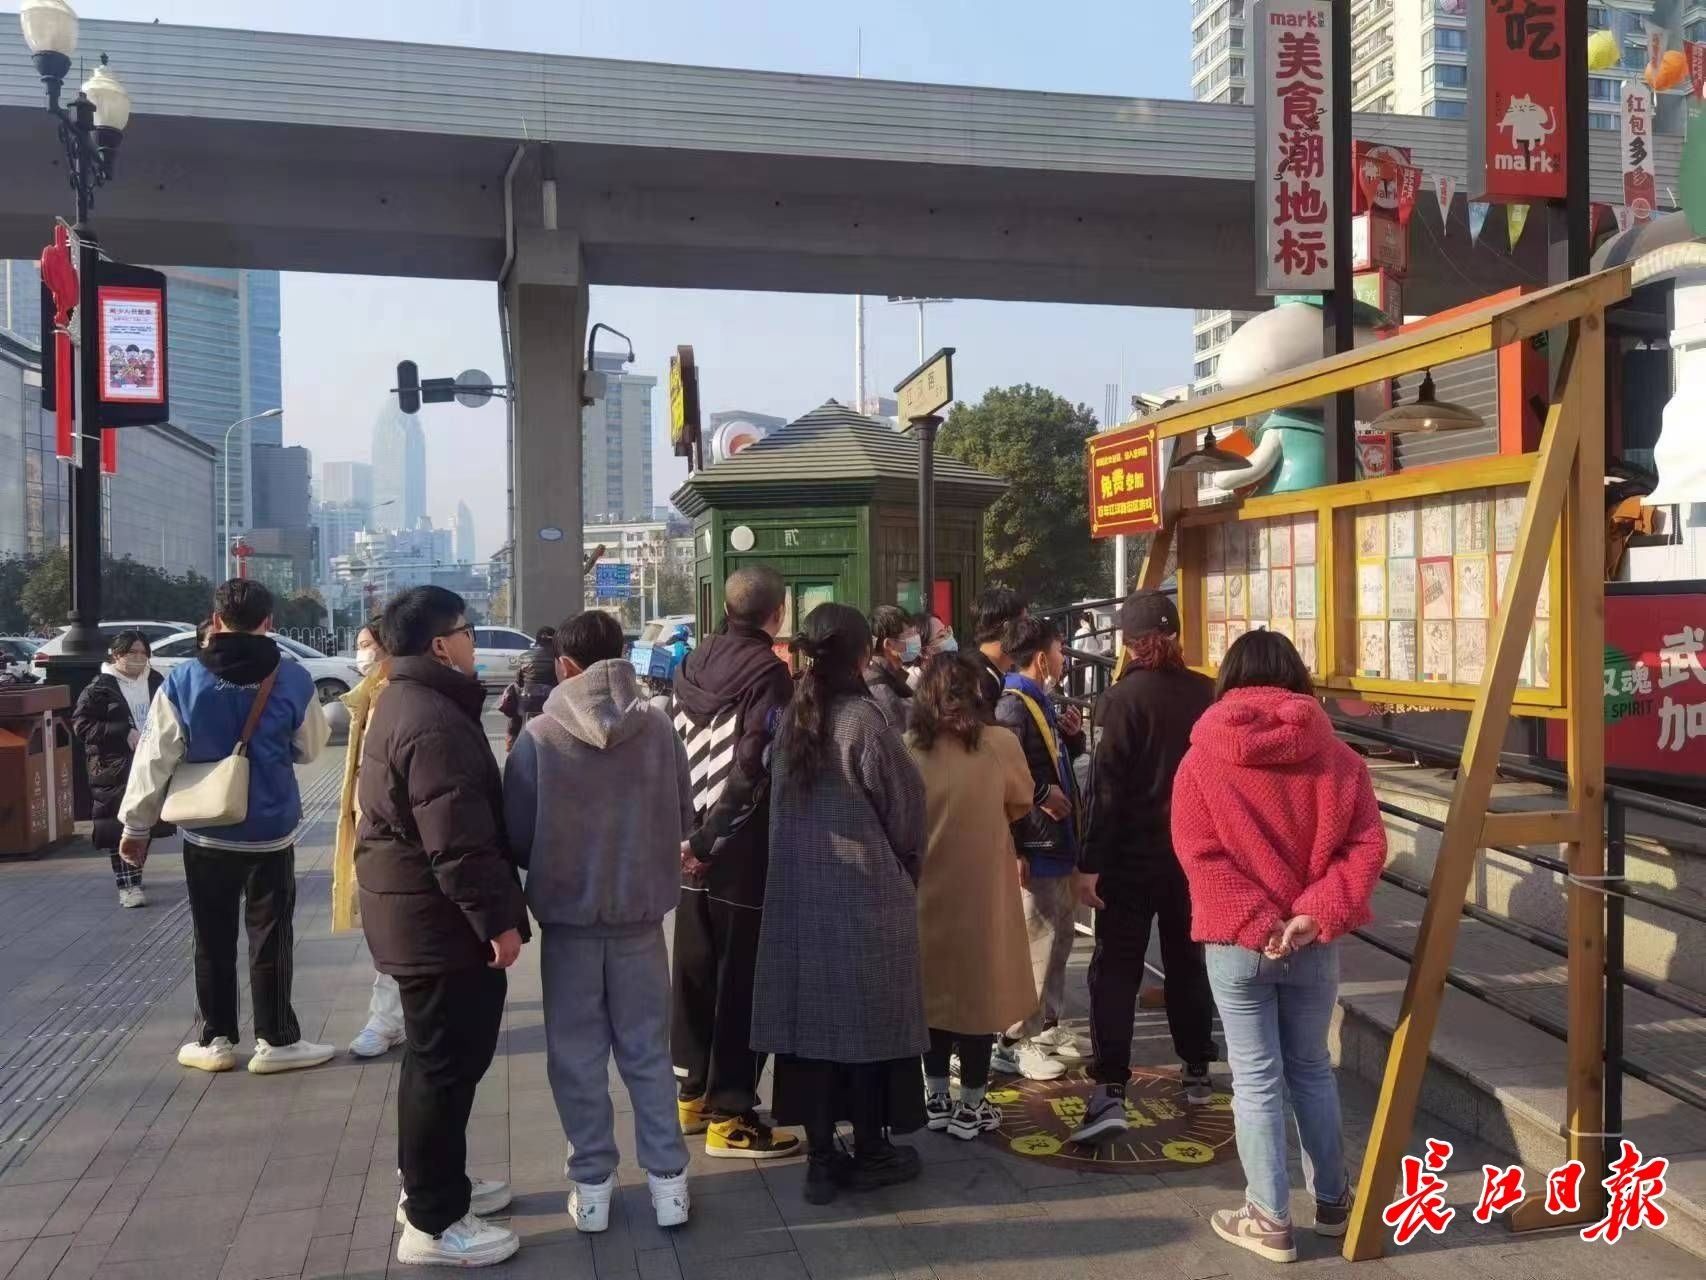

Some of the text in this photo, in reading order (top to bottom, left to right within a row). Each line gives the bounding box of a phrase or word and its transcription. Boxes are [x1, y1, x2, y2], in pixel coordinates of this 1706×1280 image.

[1270, 9, 1318, 28] mark
[1491, 0, 1561, 61] 吃
[1274, 31, 1329, 276] 美食潮地标
[1626, 93, 1649, 187] 红包多多
[1494, 150, 1553, 173] mark
[1611, 701, 1652, 719] SPIRIT
